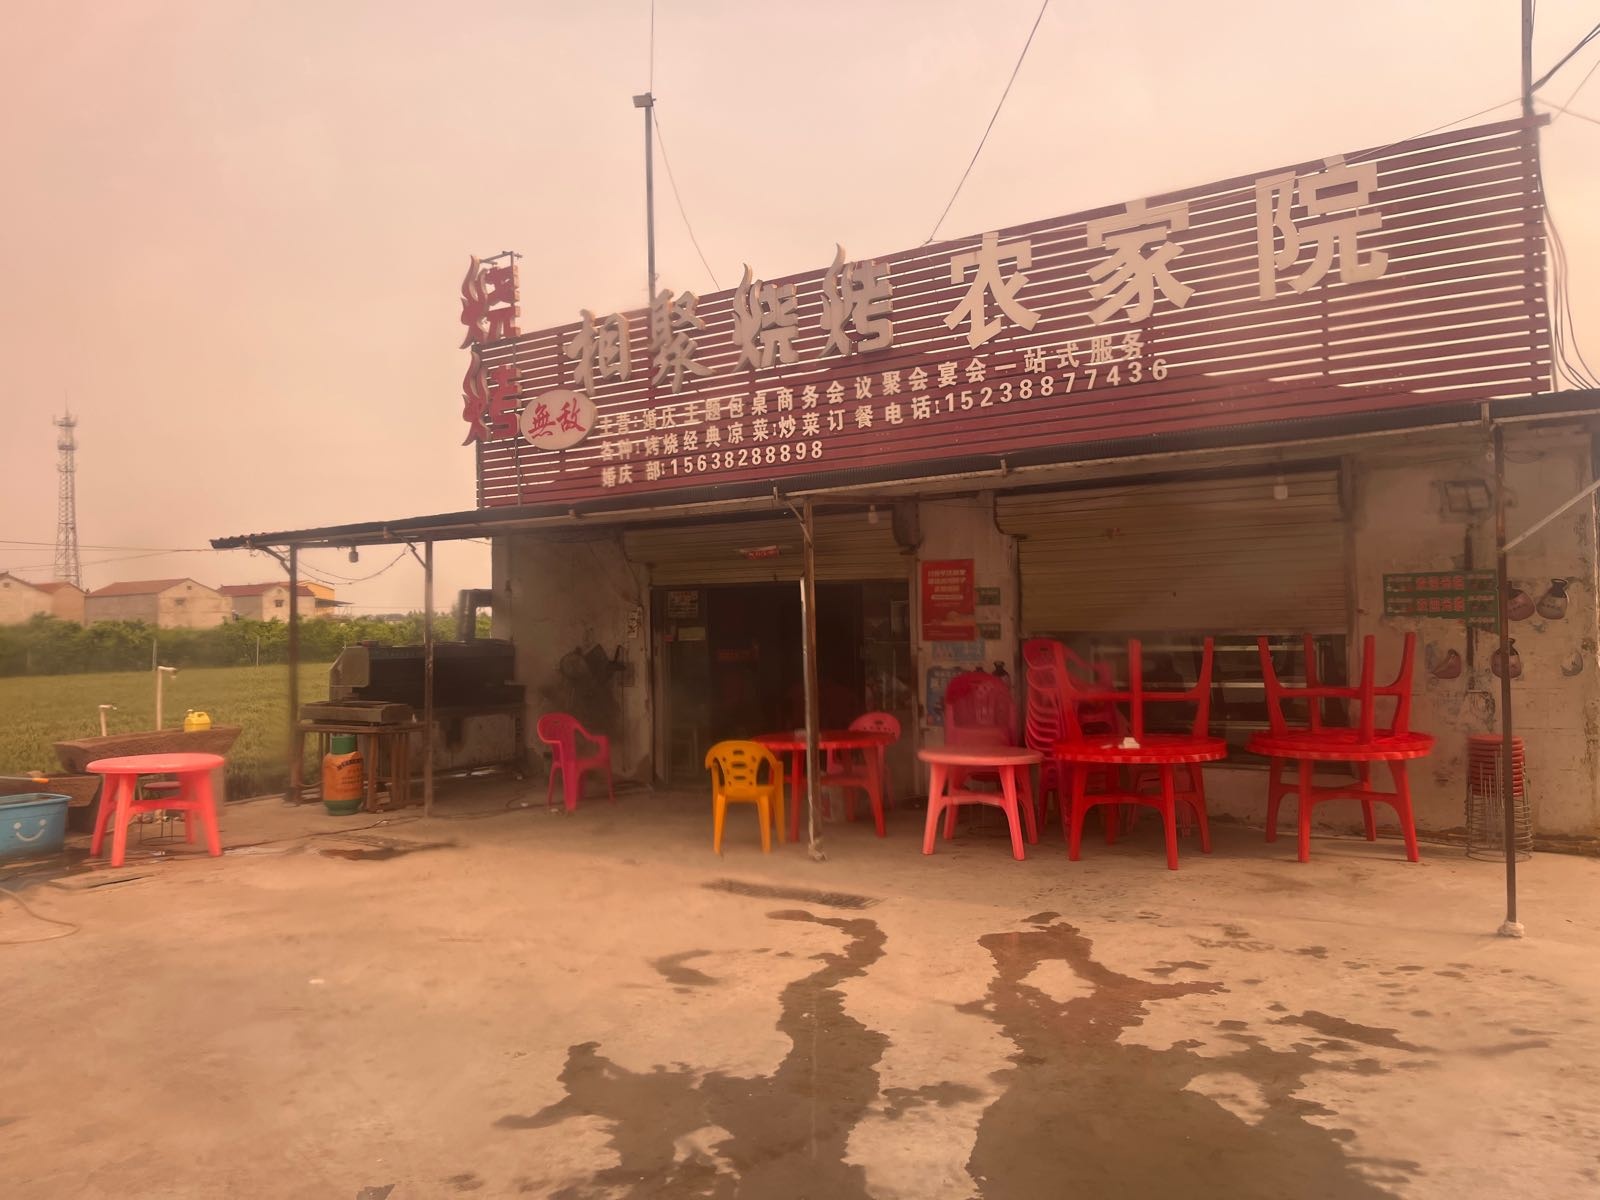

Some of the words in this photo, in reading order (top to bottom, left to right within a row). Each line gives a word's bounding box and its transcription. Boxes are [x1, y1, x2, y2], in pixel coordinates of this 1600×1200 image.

[563, 243, 895, 395] 相聚烧烤
[943, 154, 1389, 350] 农家院
